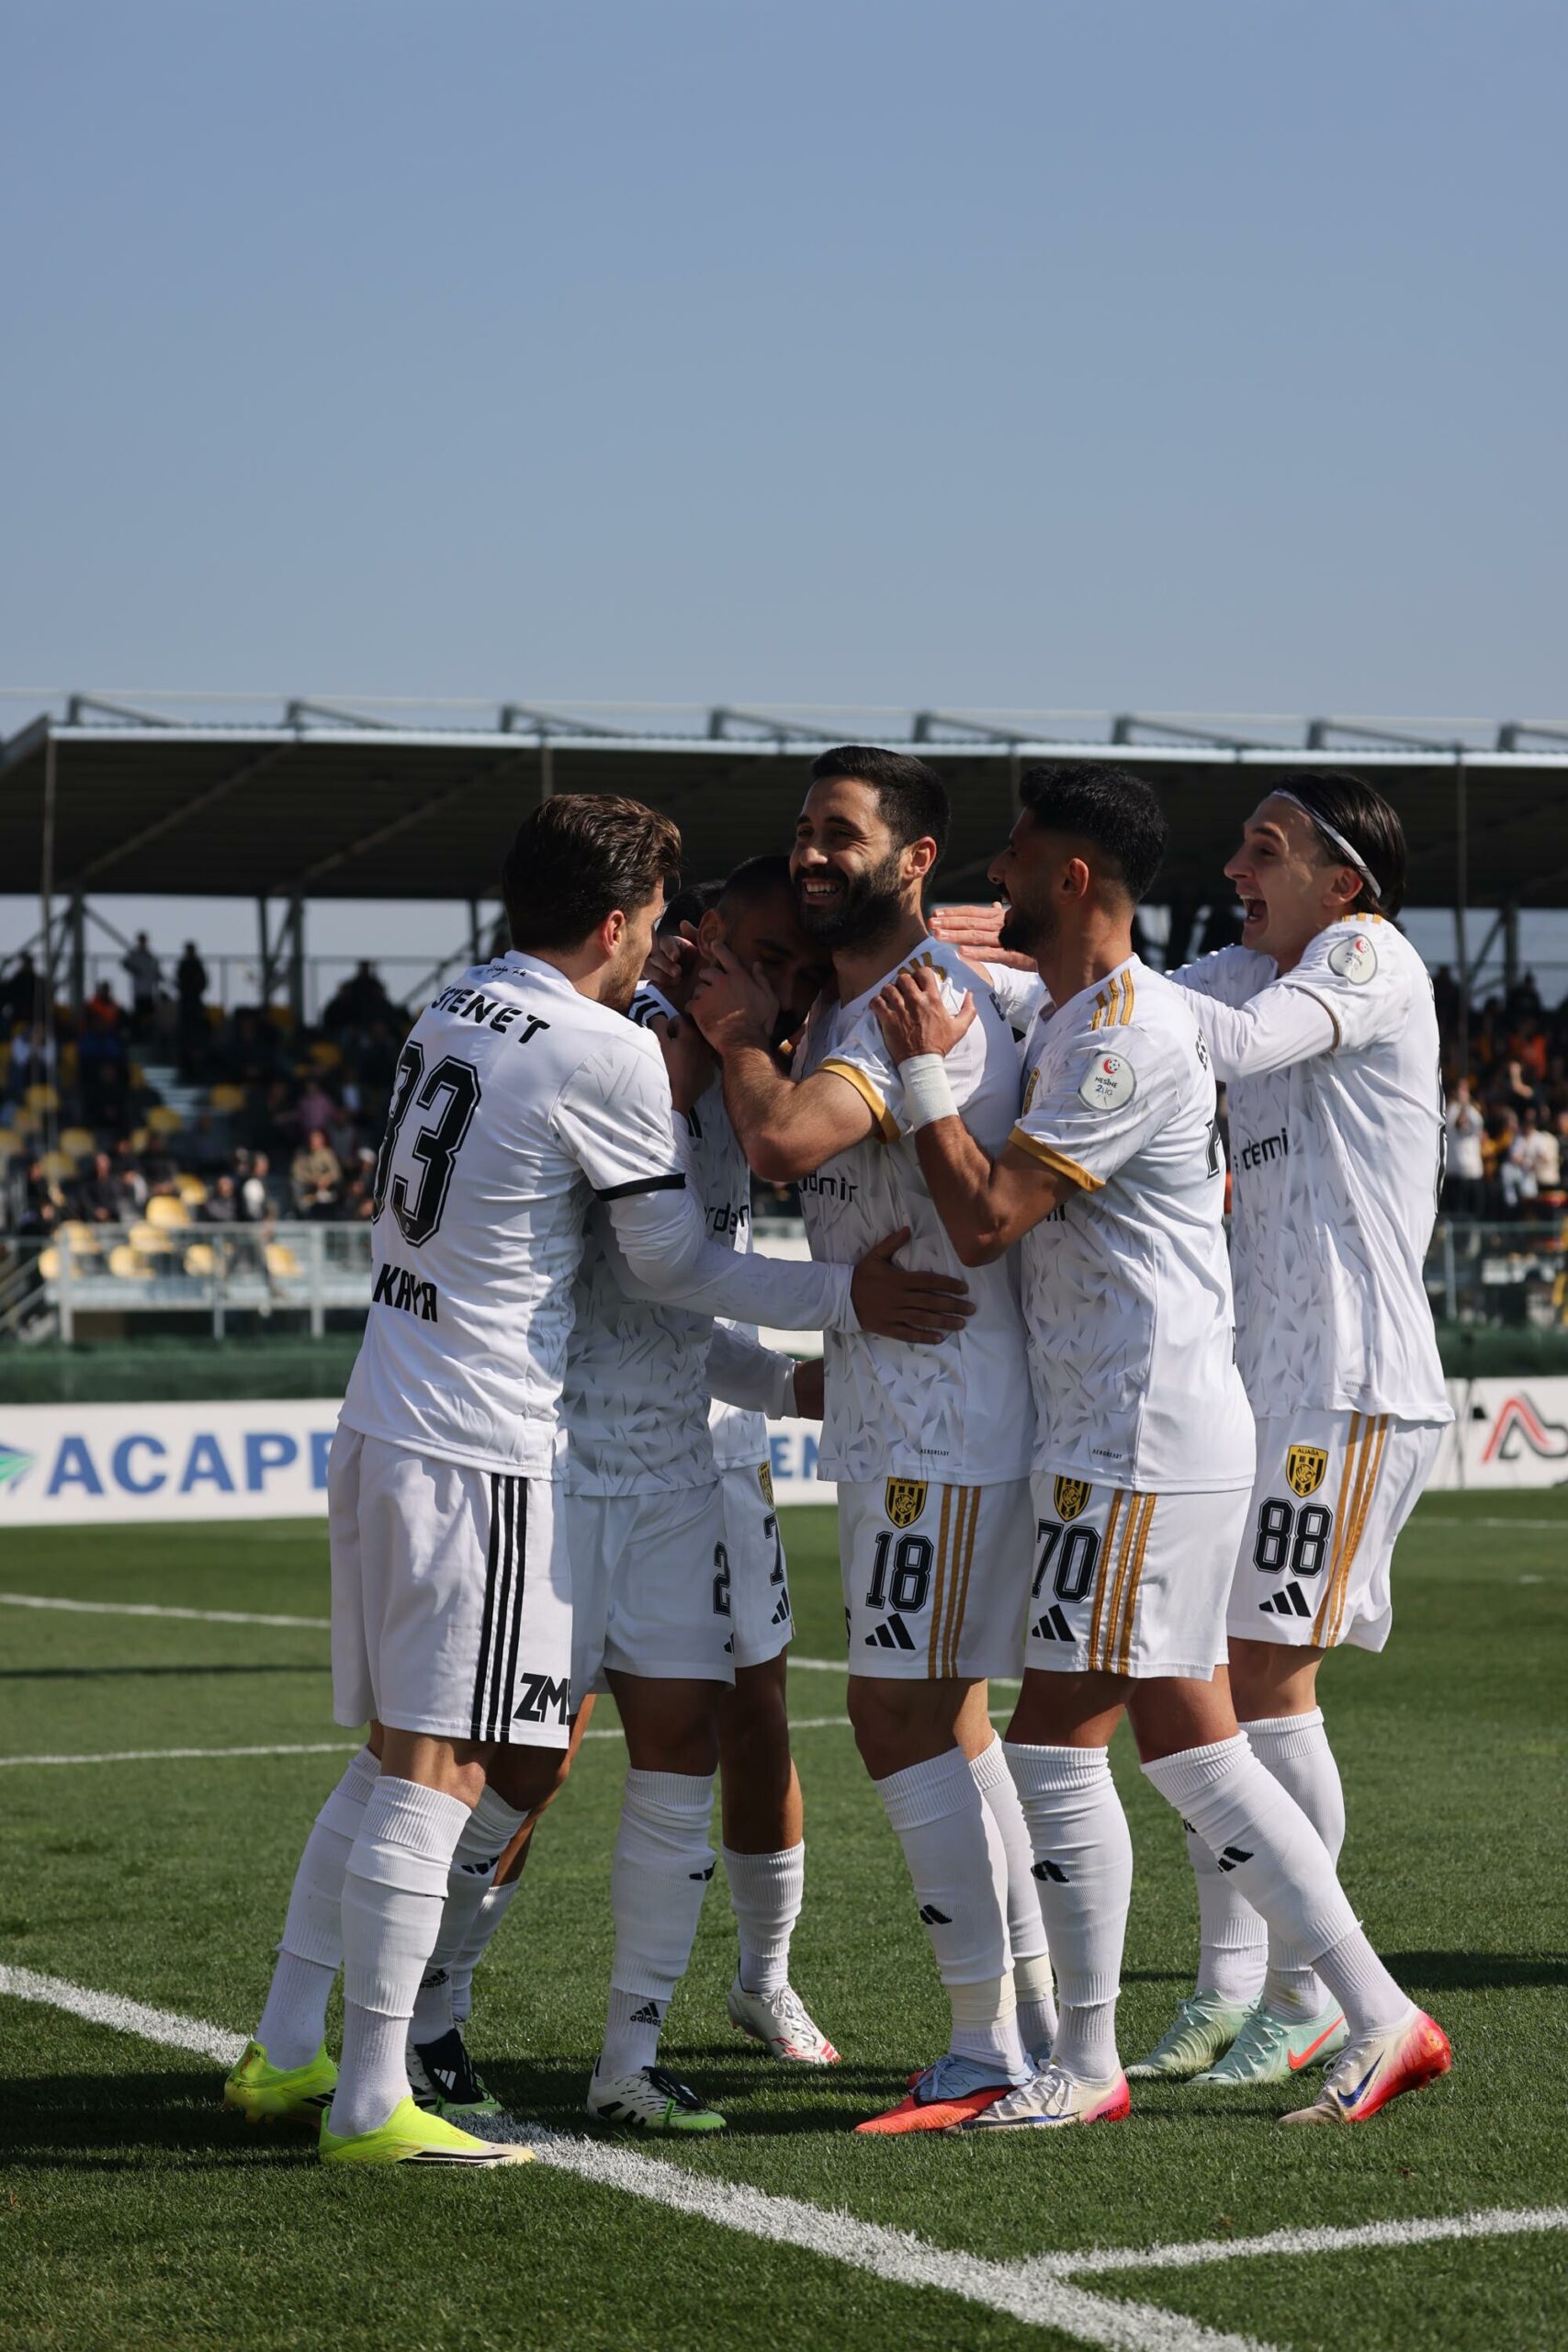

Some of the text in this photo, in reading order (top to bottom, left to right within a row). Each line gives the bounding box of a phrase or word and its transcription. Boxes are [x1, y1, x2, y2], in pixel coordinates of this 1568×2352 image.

[431, 986, 550, 1044] STENET
[372, 1262, 438, 1323] KAYA
[1031, 1518, 1102, 1604] 70
[1253, 1497, 1334, 1578] 88
[865, 1531, 934, 1613] 18
[513, 1672, 570, 1725] ZM
[630, 2014, 661, 2028] adidas
